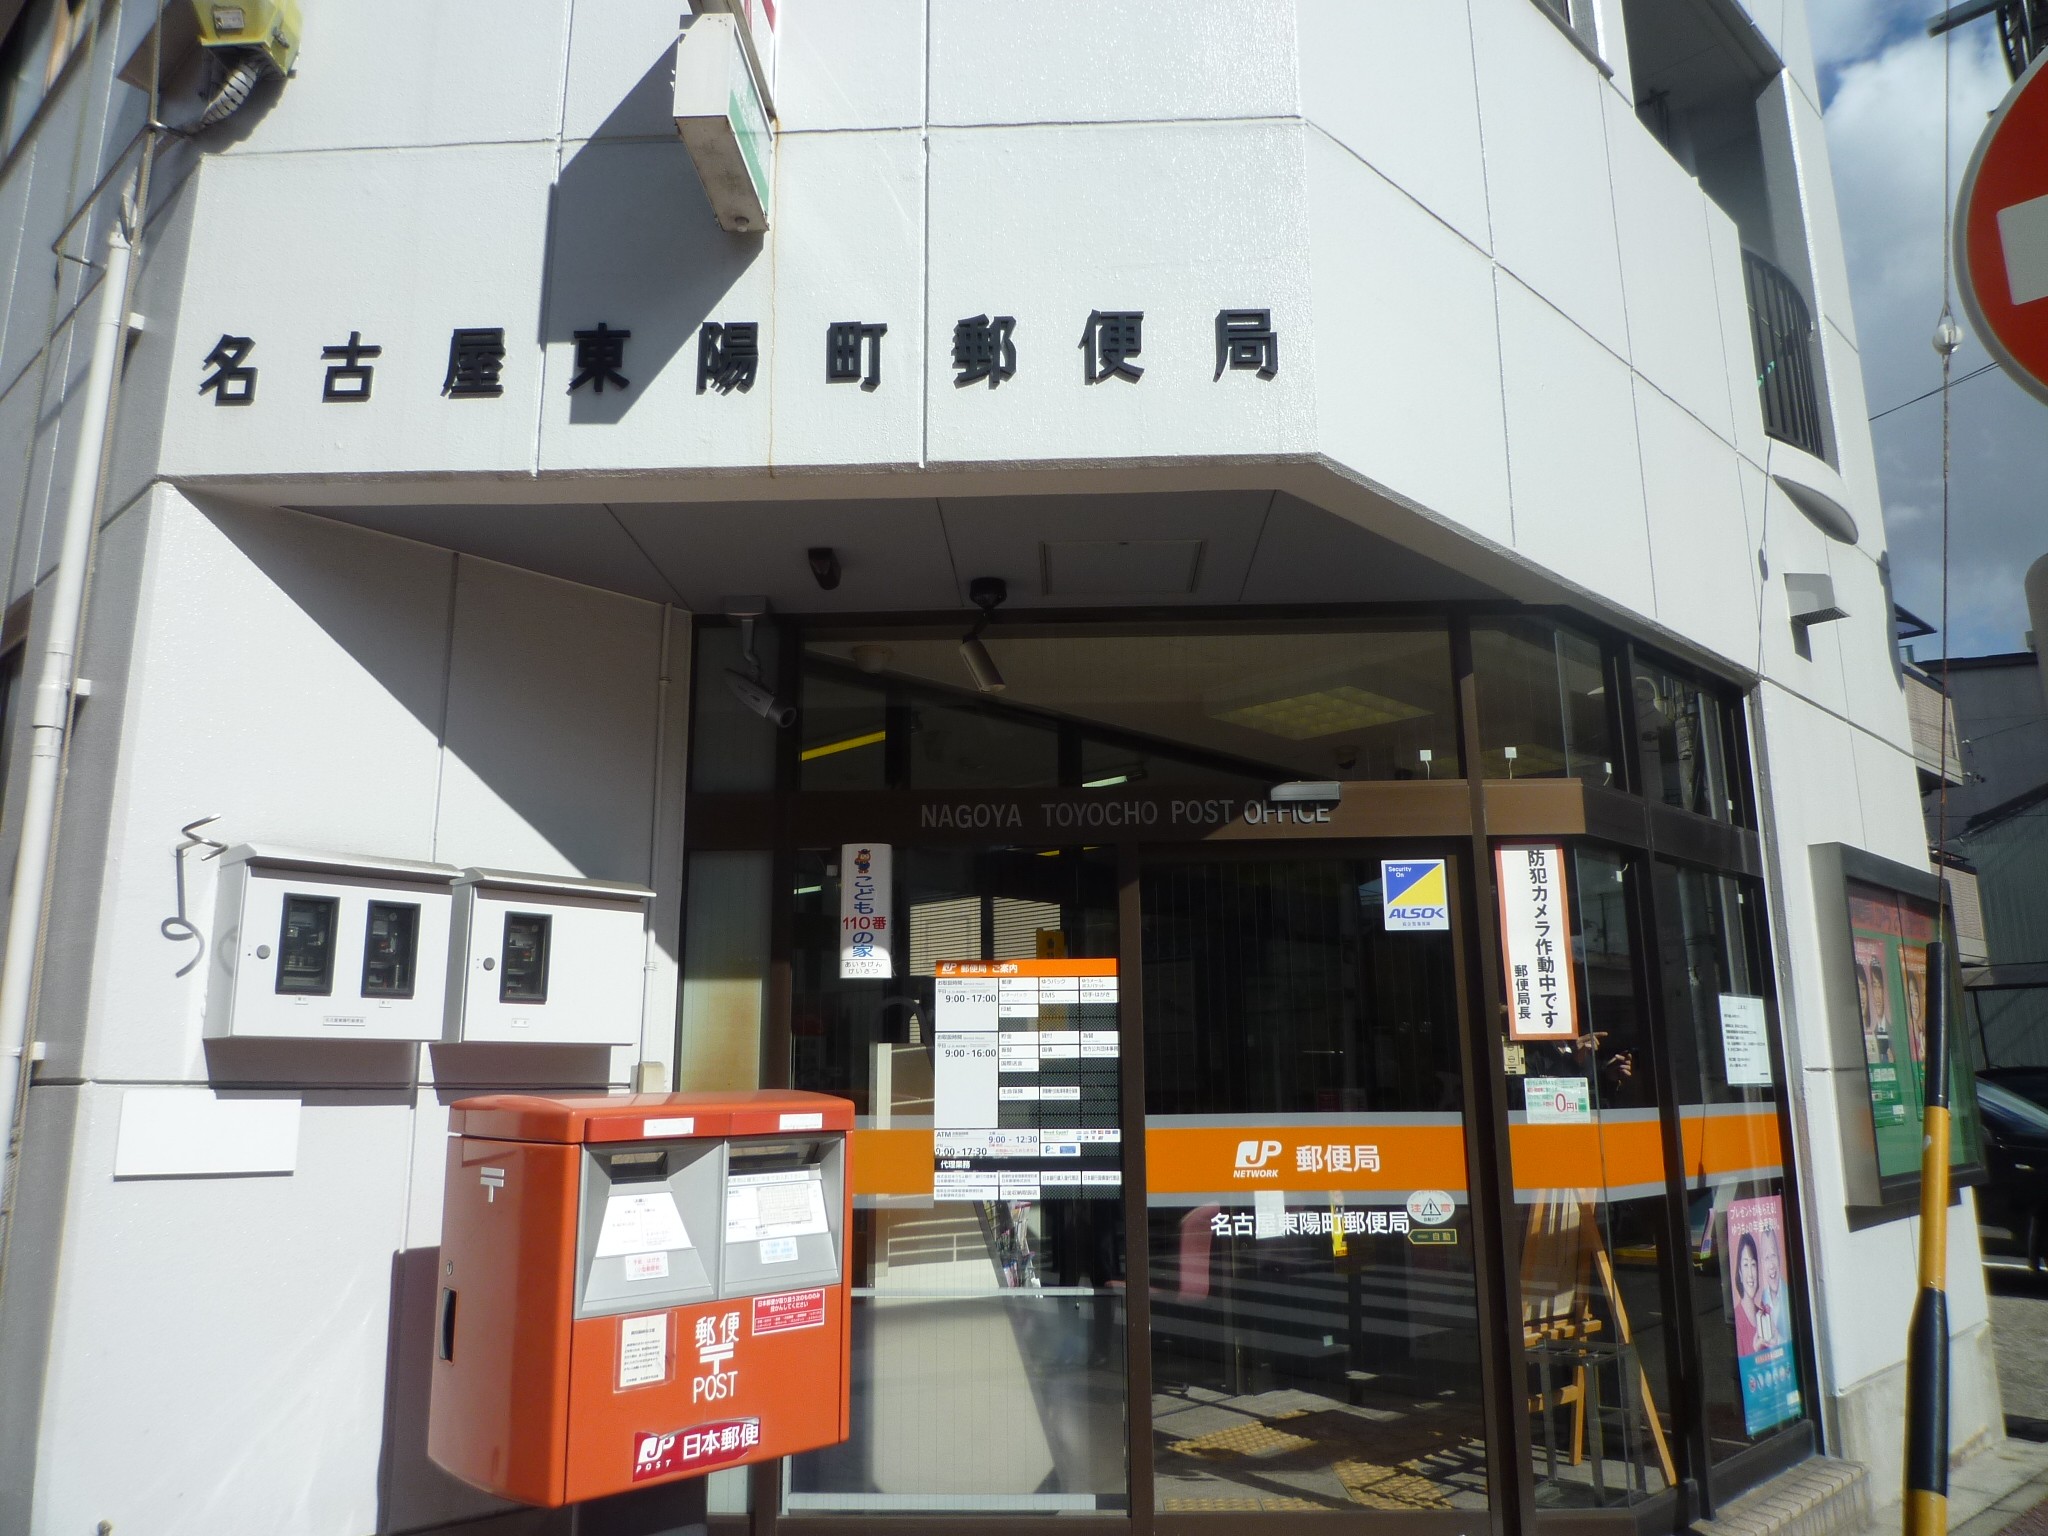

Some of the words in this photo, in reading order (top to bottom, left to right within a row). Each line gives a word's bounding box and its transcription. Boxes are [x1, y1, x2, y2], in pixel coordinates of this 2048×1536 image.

[199, 308, 1278, 405] 名古屋東陽町郵便局
[921, 804, 1022, 828] NAGOYA
[1041, 801, 1158, 828] TOYOCHO
[1171, 800, 1234, 824] POST
[1388, 907, 1445, 919] ALSOK
[1527, 850, 1558, 1028] 防犯カメラ作動中です
[961, 963, 987, 974] 郵便局
[992, 963, 1018, 974] ご案内
[945, 994, 965, 1003] 9:00
[972, 994, 997, 1003] 17:00
[1514, 964, 1531, 1020] 郵便局長
[945, 1049, 965, 1058] 9:00
[972, 1049, 997, 1058] 16:00
[962, 1147, 987, 1156] 17:30
[988, 1136, 1006, 1144] 9:00
[1016, 1136, 1038, 1144] 12:30
[1296, 1144, 1381, 1173] 郵便局
[1233, 1169, 1279, 1178] NETWORK
[1210, 1211, 1411, 1237] 名古屋東陽町郵便局
[695, 1311, 741, 1348] 郵便
[693, 1370, 739, 1404] POST
[683, 1423, 759, 1460] 日本郵便
[635, 1458, 673, 1473] POST
